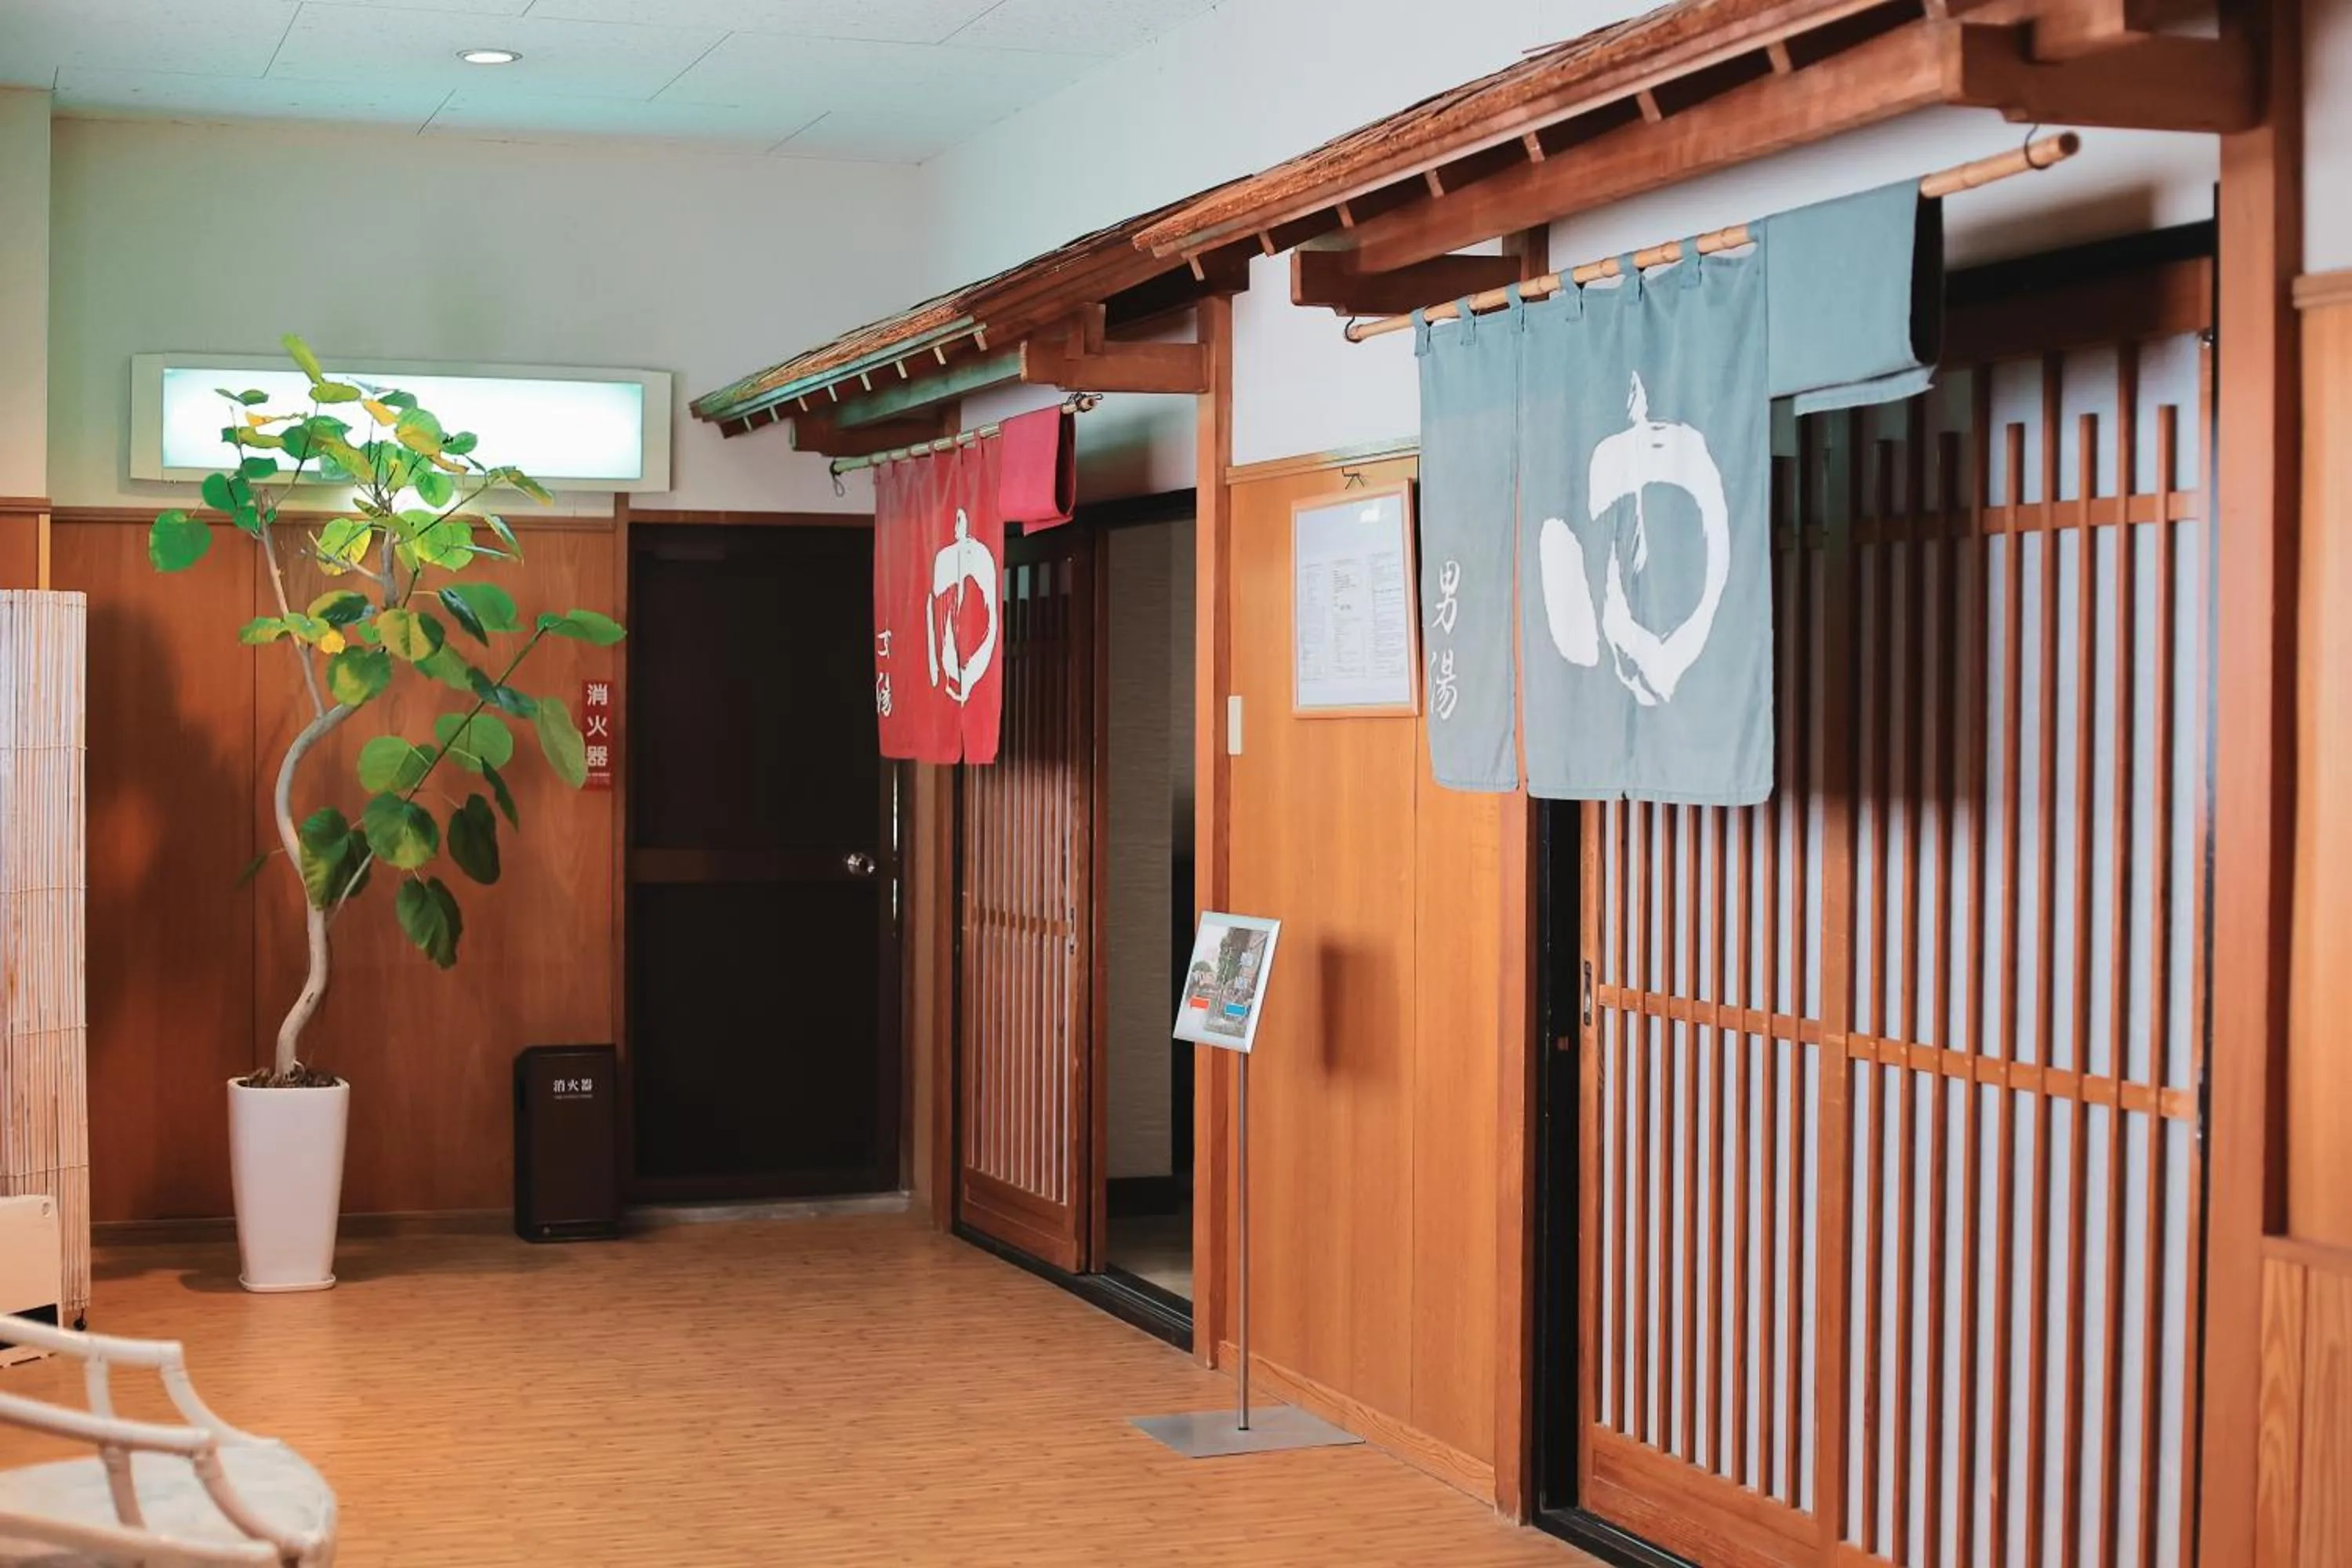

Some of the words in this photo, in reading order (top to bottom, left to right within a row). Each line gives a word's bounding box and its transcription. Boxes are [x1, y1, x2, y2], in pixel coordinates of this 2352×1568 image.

[926, 507, 997, 707] ゆ
[1539, 370, 1730, 706] ゆ
[1428, 561, 1461, 720] 男湯
[586, 683, 608, 767] 消火器
[553, 1078, 593, 1093] 消火器
